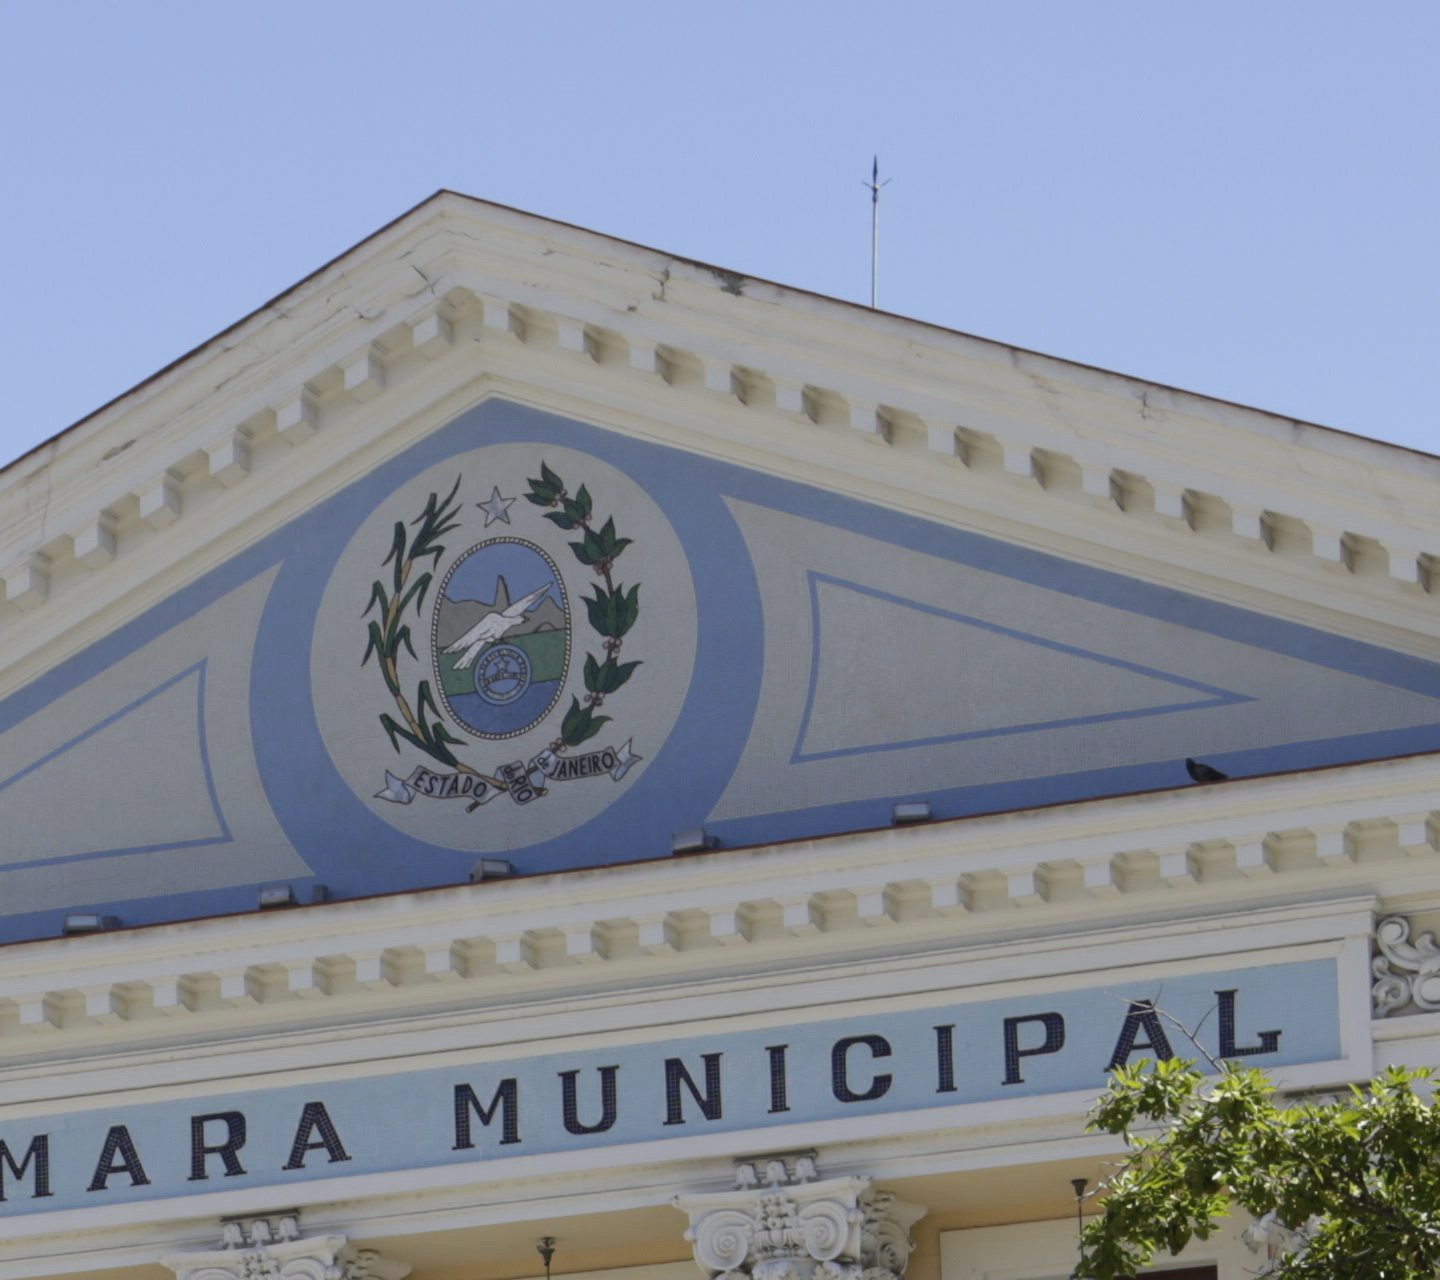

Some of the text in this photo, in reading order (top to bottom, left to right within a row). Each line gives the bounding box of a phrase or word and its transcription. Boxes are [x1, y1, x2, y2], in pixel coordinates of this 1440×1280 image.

[414, 771, 487, 798] ESTADO
[511, 776, 533, 803] RIO
[550, 752, 615, 777] JANEIRO
[451, 988, 1283, 1150] MUNICIPAL
